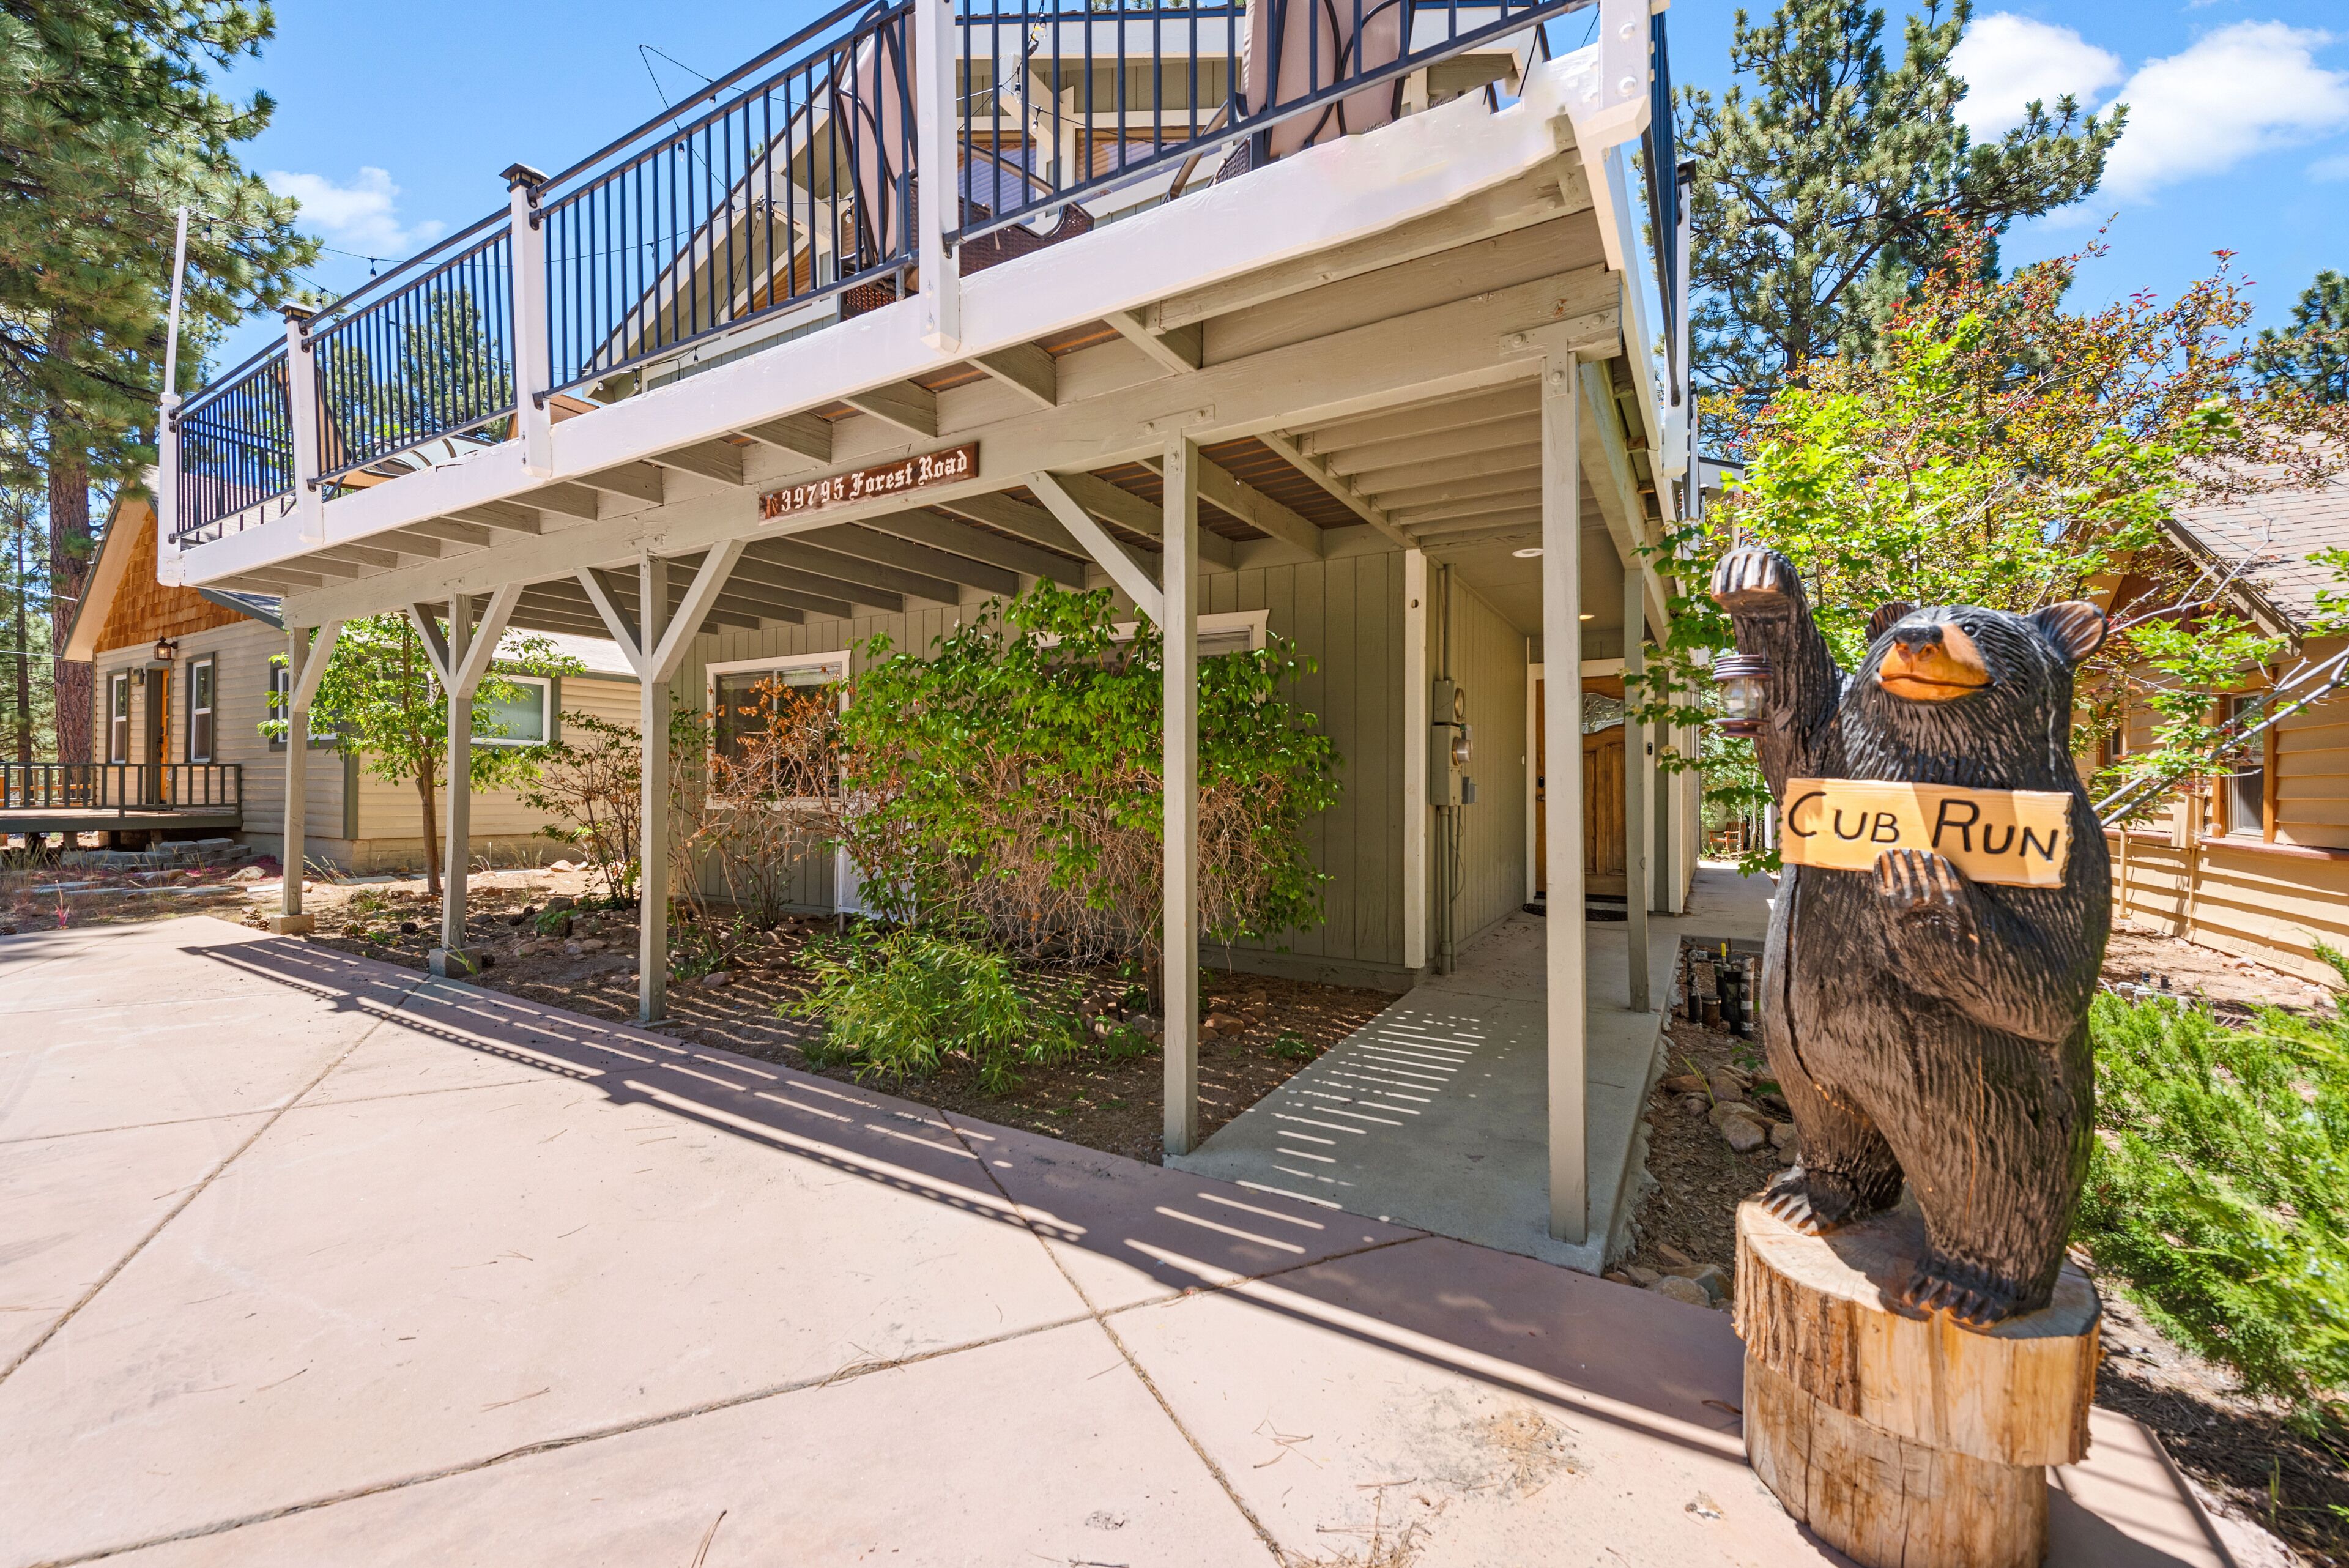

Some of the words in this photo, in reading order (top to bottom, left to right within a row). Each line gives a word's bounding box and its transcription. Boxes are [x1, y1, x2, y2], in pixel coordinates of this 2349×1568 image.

[781, 477, 844, 511] 39795
[849, 463, 913, 500] Forest
[918, 450, 967, 485] Road
[1788, 791, 1900, 844] CUB
[1931, 798, 2059, 861] RUN
